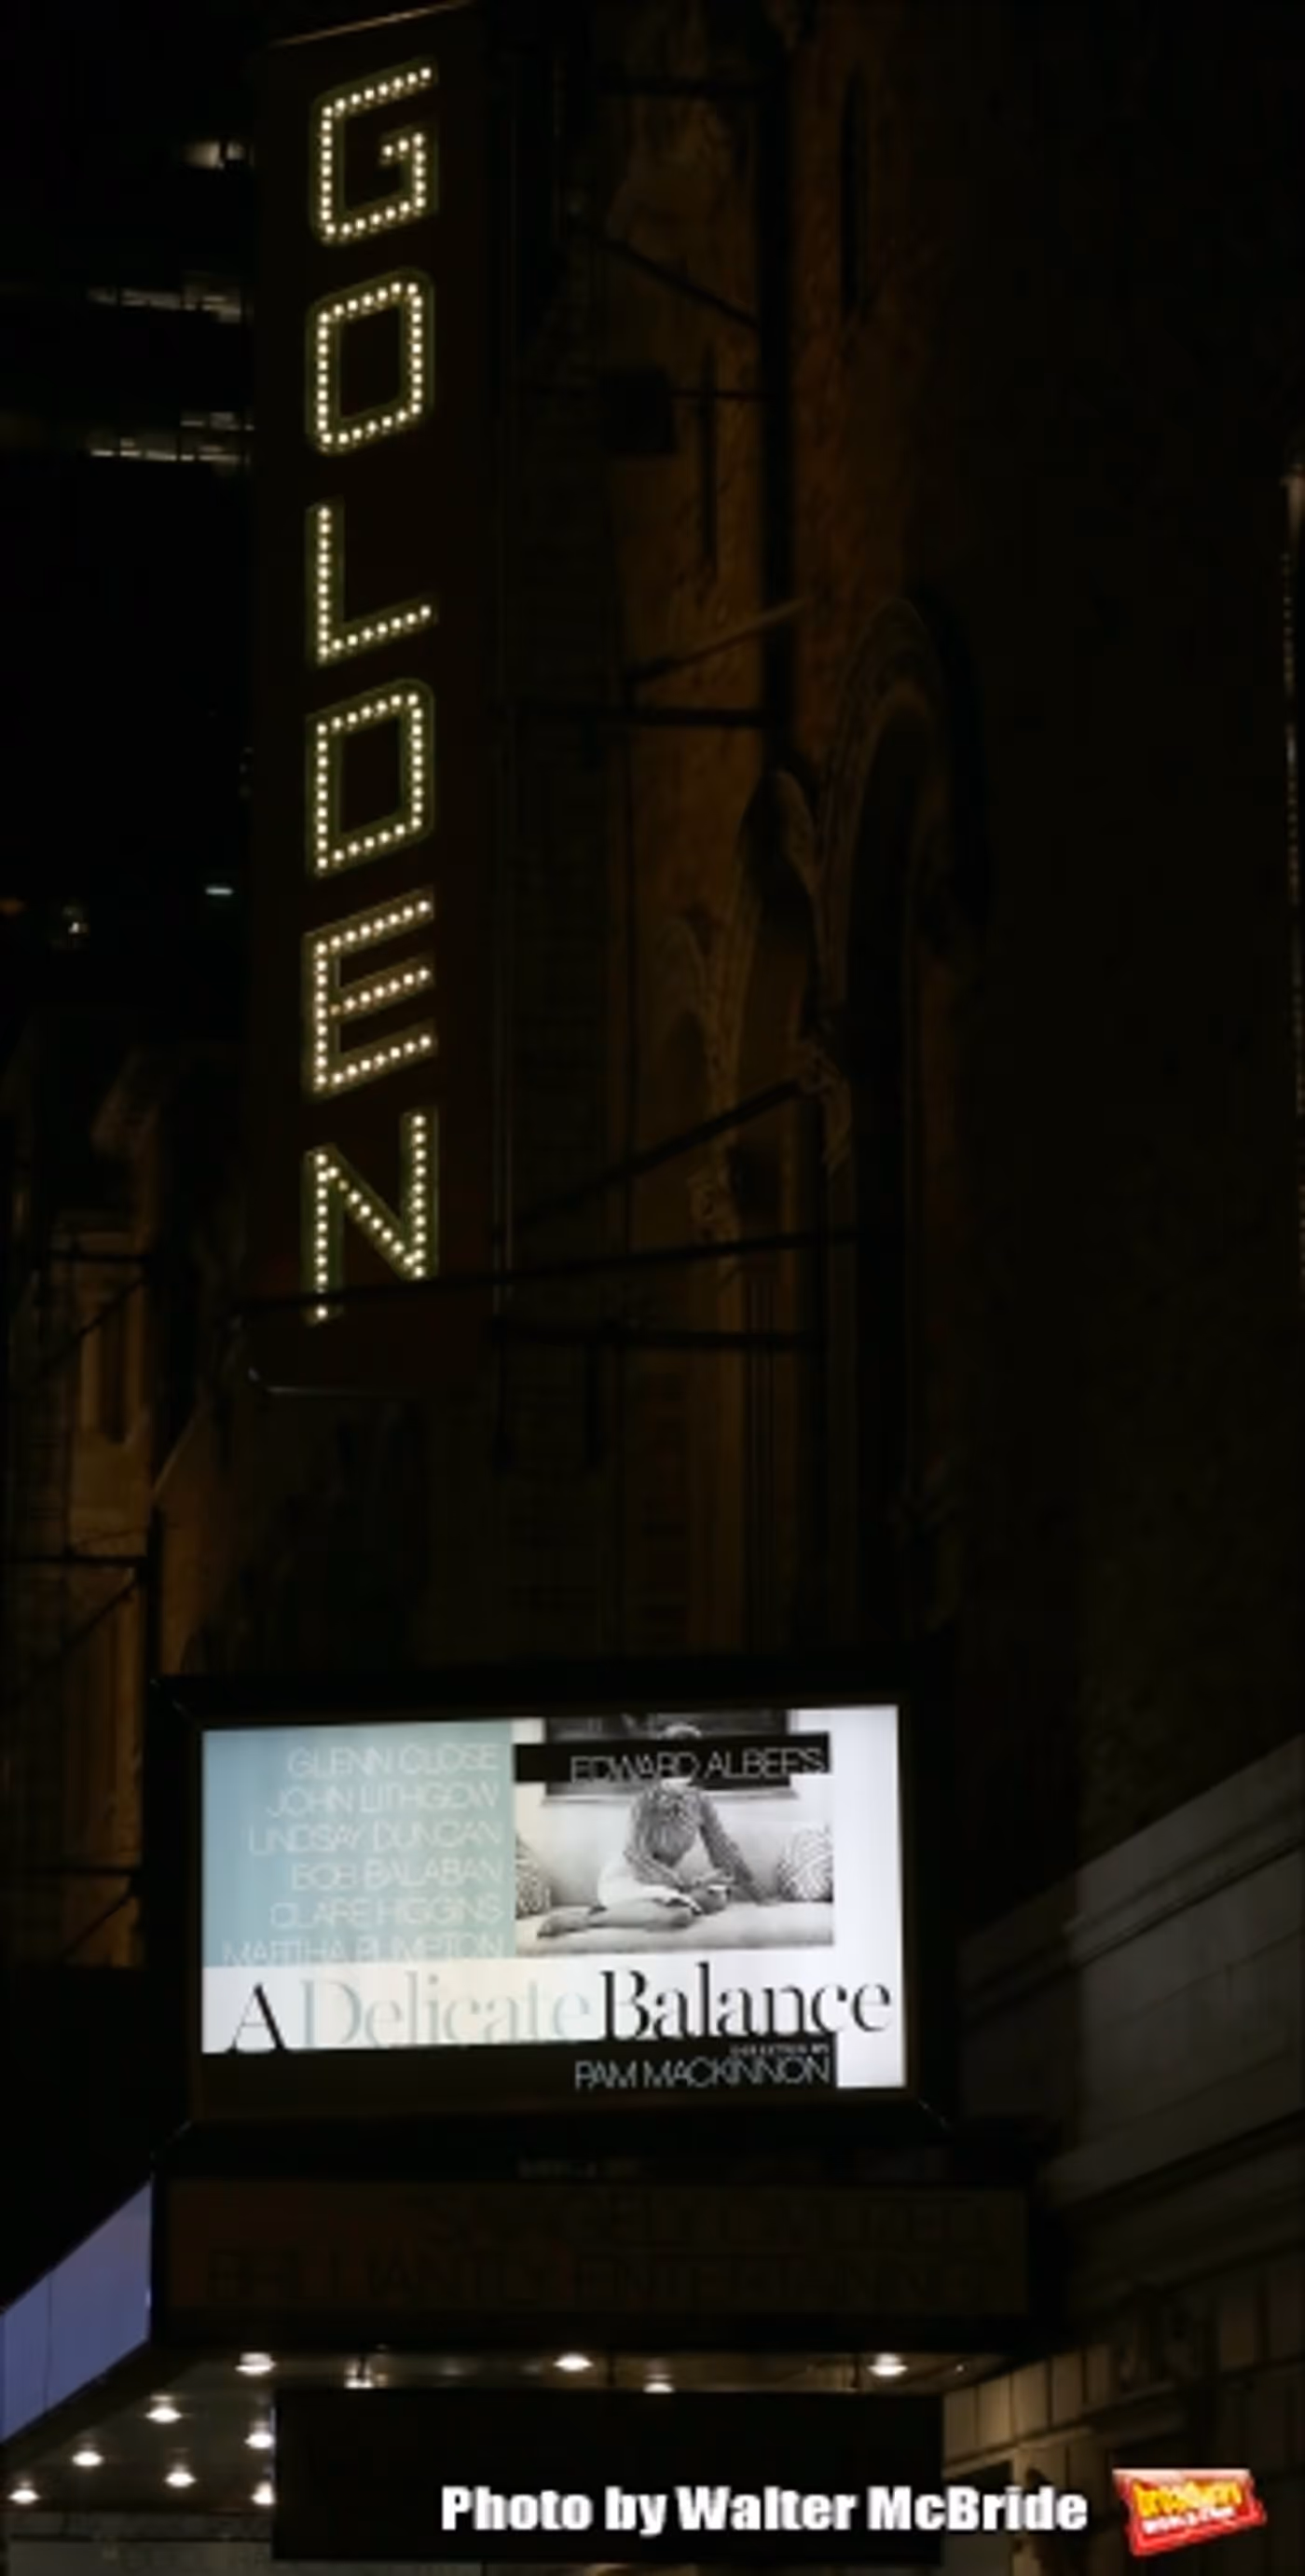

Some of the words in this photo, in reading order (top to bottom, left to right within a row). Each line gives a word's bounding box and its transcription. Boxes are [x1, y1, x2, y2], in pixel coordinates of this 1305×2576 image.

[306, 60, 437, 1322] GOLDEN
[285, 1743, 390, 1778] GLENN
[397, 1742, 500, 1775] CLOSE
[569, 1755, 700, 1783] EDWARD
[266, 1784, 354, 1817] JOHN
[359, 1779, 500, 1813] LITHGOW
[247, 1822, 364, 1856] LINDSAY
[372, 1818, 503, 1853] DUNCAN
[291, 1863, 355, 1891] BOB
[363, 1858, 504, 1891] BALABAN
[268, 1899, 367, 1929] CLARE
[375, 1893, 504, 1927] HIGGINS
[225, 1982, 291, 2053] A
[298, 1969, 591, 2051] Delicate
[599, 1961, 892, 2042] Balance
[574, 2059, 637, 2089] PAM
[643, 2054, 831, 2088] MACKINNON
